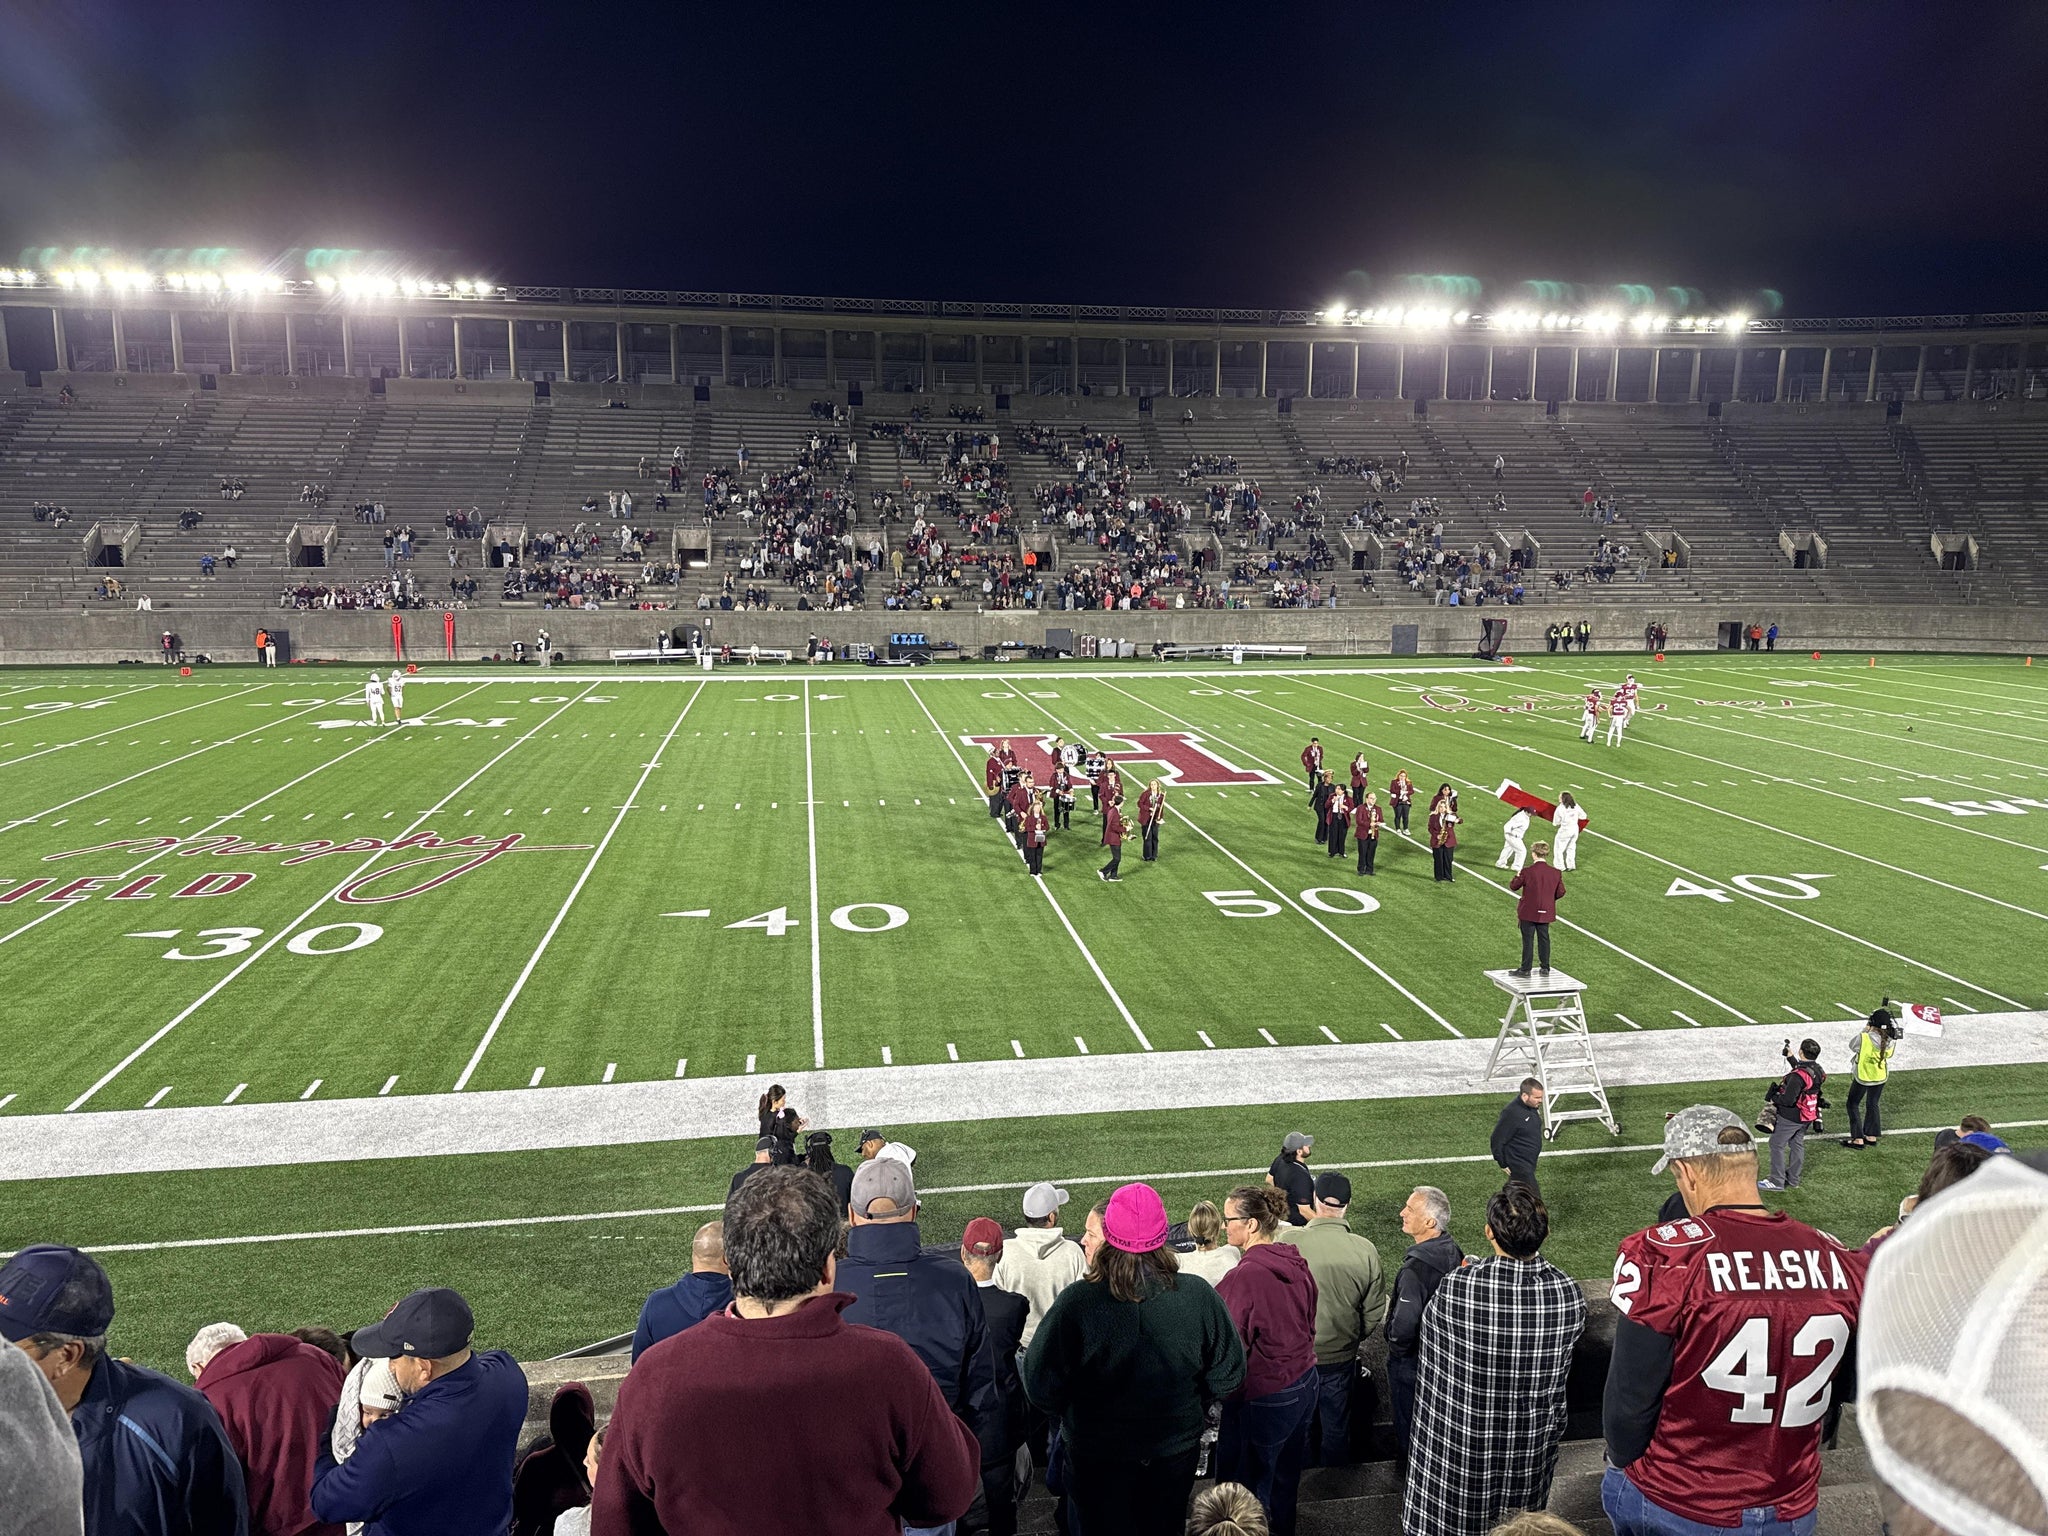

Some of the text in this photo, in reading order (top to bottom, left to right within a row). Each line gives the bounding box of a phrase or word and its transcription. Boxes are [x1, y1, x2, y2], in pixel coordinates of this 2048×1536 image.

[371, 687, 380, 695] 48
[529, 696, 619, 704] 30
[763, 693, 846, 701] 40
[980, 691, 1062, 699] 50
[1188, 688, 1262, 696] 40
[1613, 703, 1627, 713] 25
[958, 731, 1285, 788] H
[1066, 750, 1074, 761] H
[42, 831, 595, 903] Murphy
[0, 872, 257, 903] IELD
[1200, 887, 1381, 917] 50
[1664, 874, 1821, 903] 40
[722, 902, 910, 936] 40
[161, 922, 384, 960] 30
[1706, 1249, 1849, 1292] REASKA
[1700, 1313, 1850, 1428] 42
